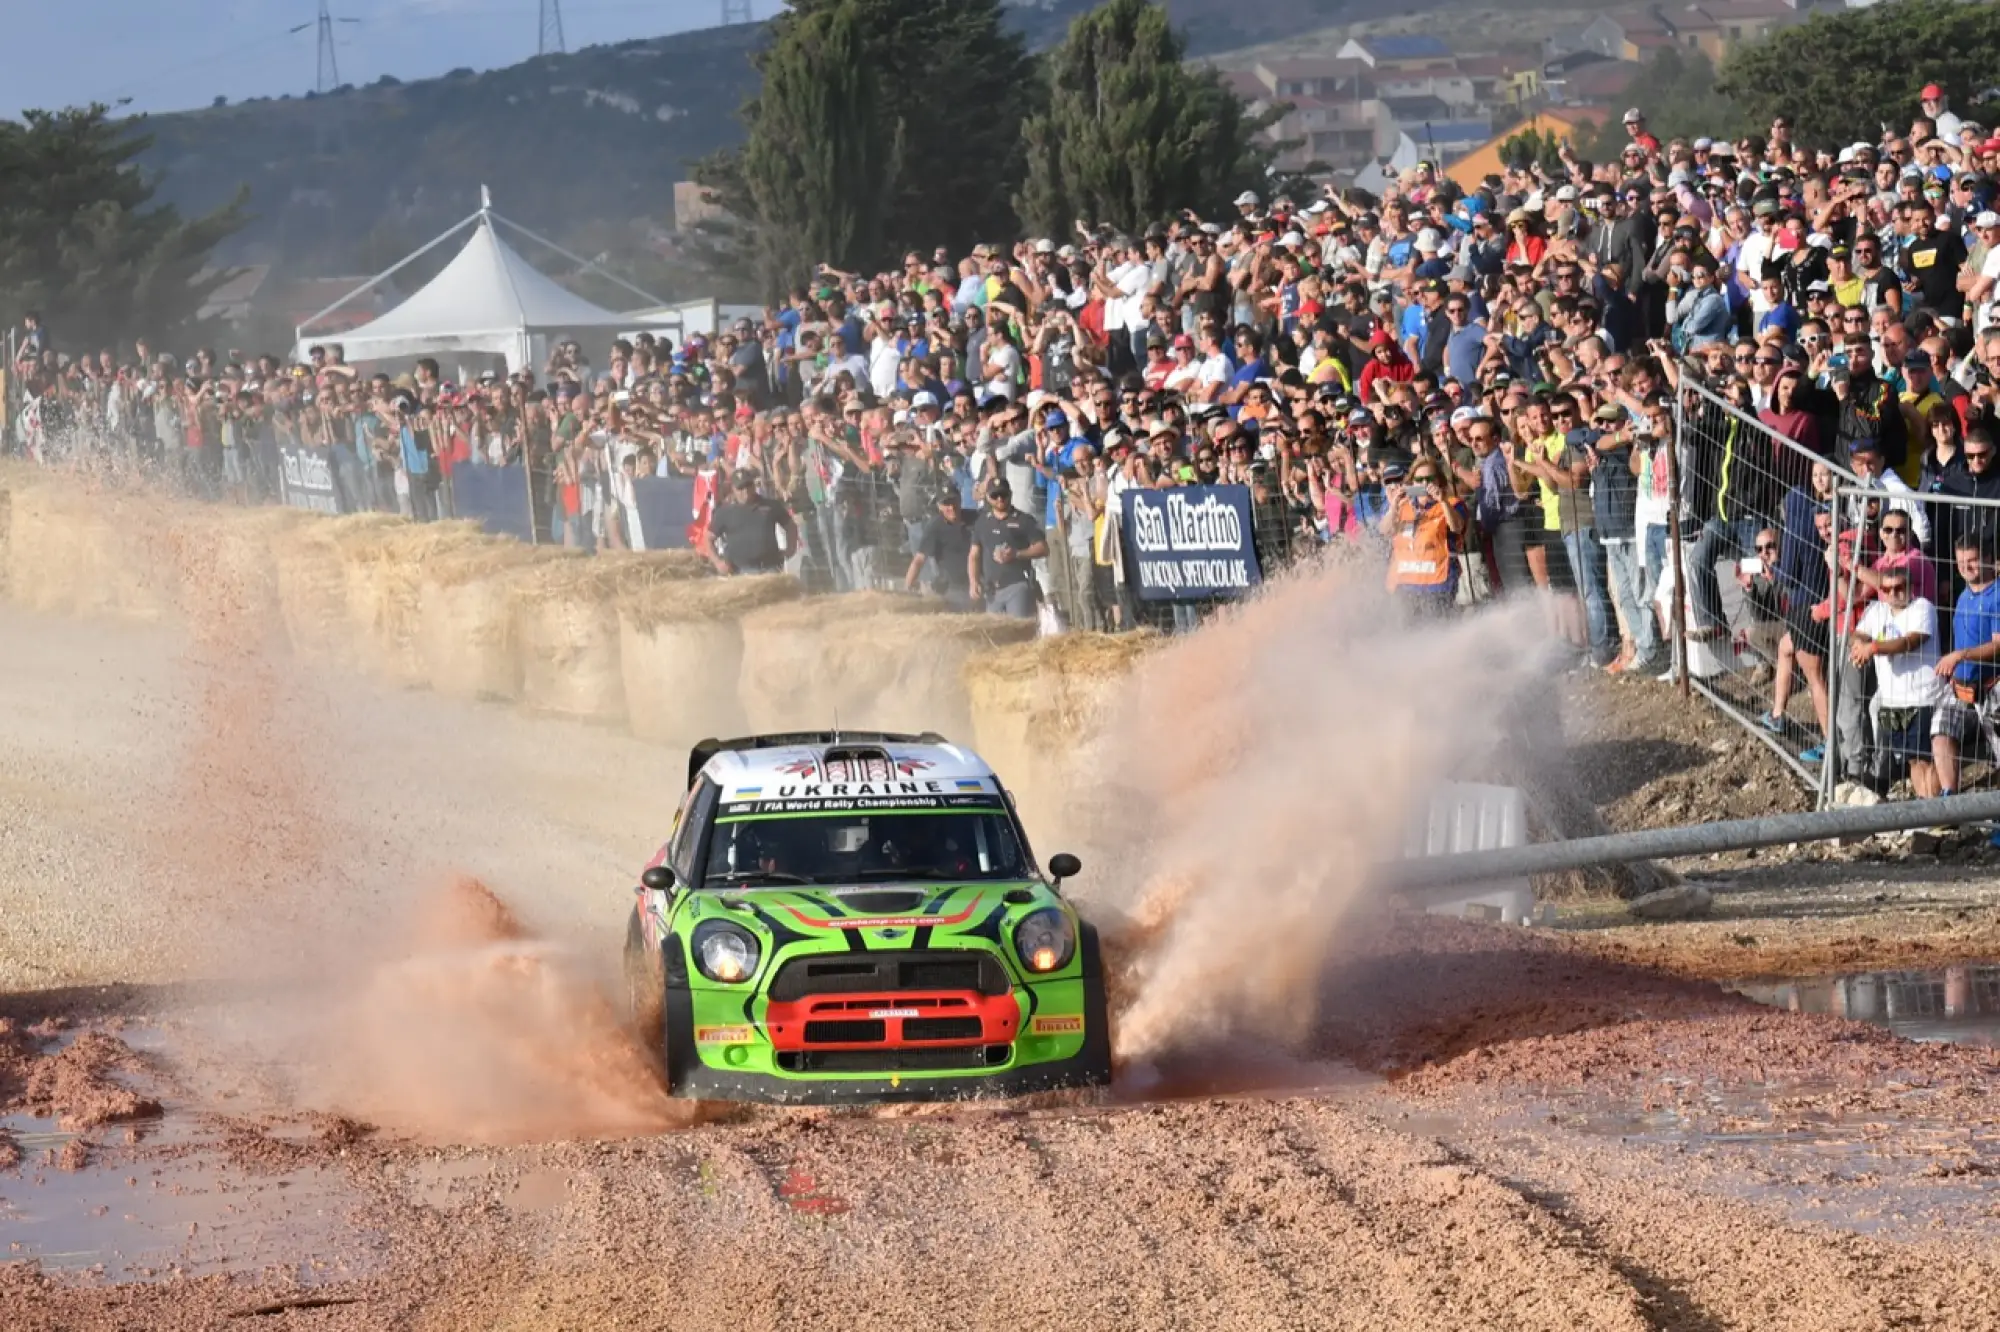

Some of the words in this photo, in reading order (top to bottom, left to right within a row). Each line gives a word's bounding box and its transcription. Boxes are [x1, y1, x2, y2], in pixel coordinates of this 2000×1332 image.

[1134, 494, 1168, 552] San
[1167, 493, 1241, 551] Martino
[779, 781, 943, 797] UKRAINE
[763, 801, 784, 812] FIA
[786, 800, 821, 811] World
[824, 798, 855, 810] Rally
[857, 797, 937, 808] Championship
